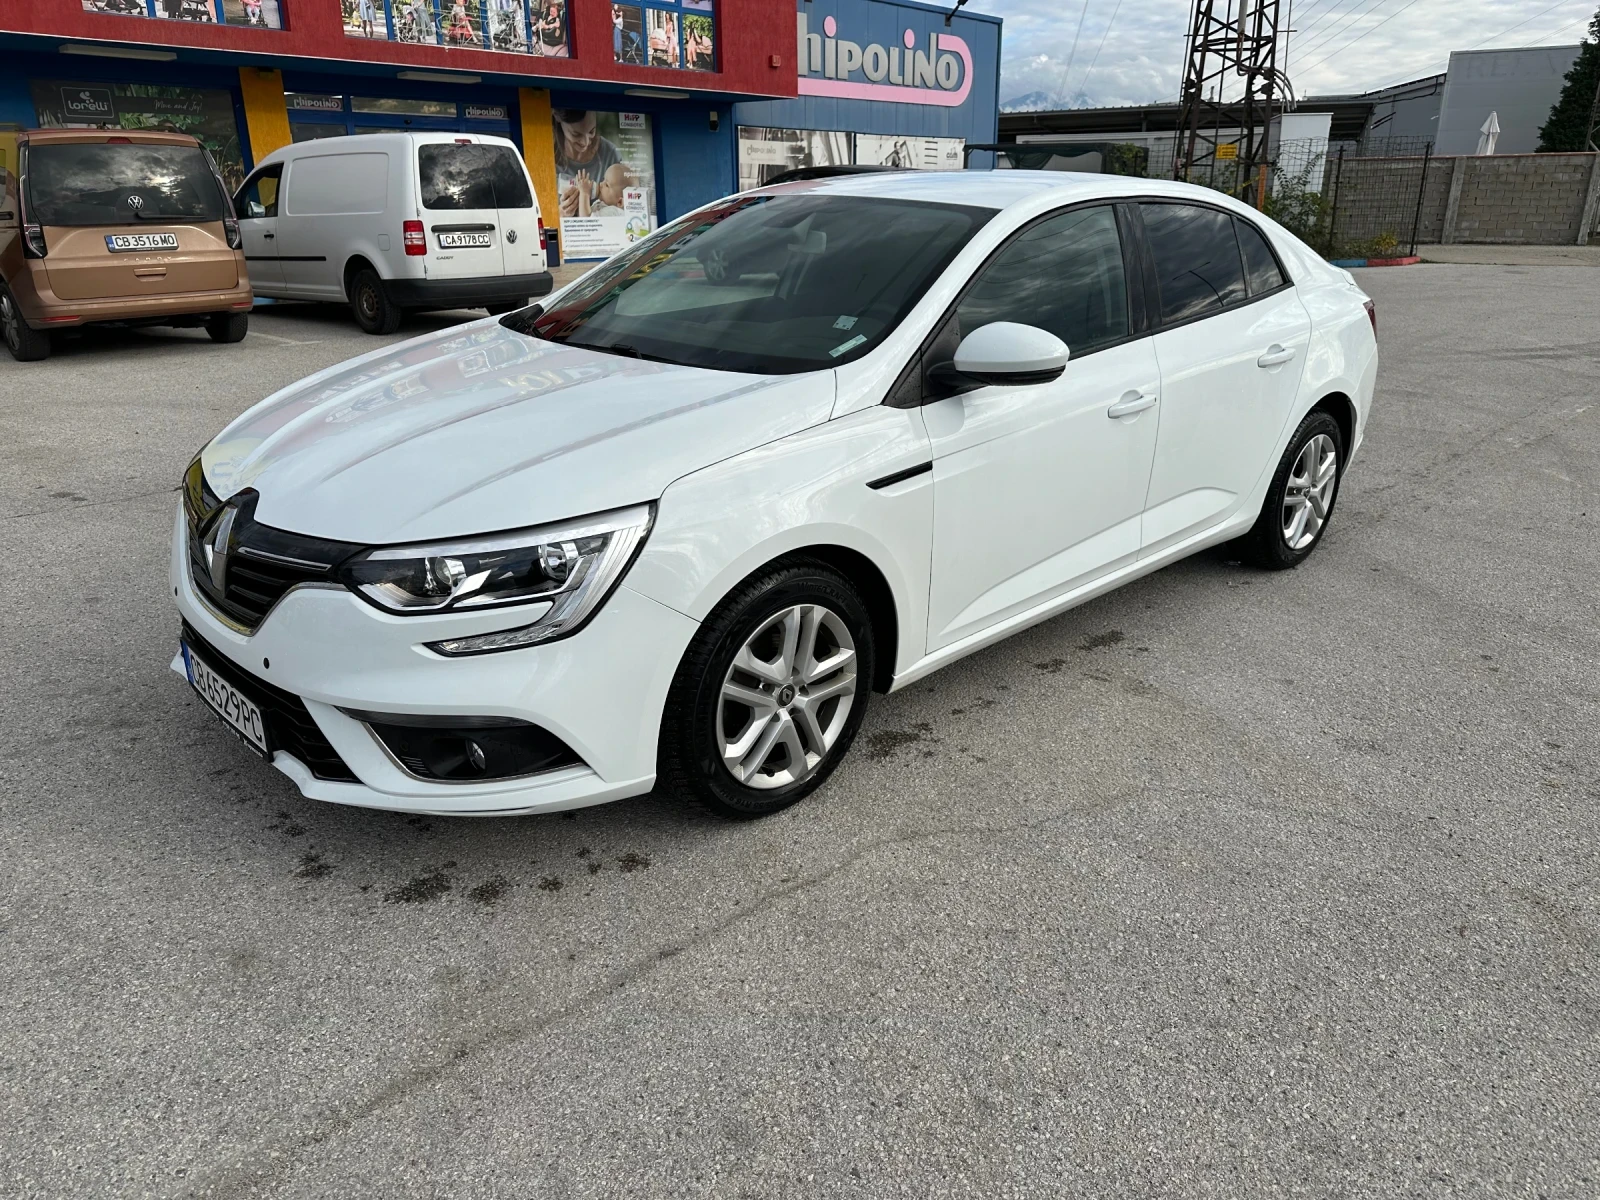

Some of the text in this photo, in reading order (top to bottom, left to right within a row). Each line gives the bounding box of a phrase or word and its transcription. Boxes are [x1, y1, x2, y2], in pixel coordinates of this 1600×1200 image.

[114, 236, 131, 248] CB
[131, 235, 159, 247] 3516
[160, 234, 175, 246] MO
[445, 234, 489, 245] CA 9178 CC
[190, 654, 206, 693] CB
[207, 670, 240, 723] 6529
[240, 698, 262, 743] PC
